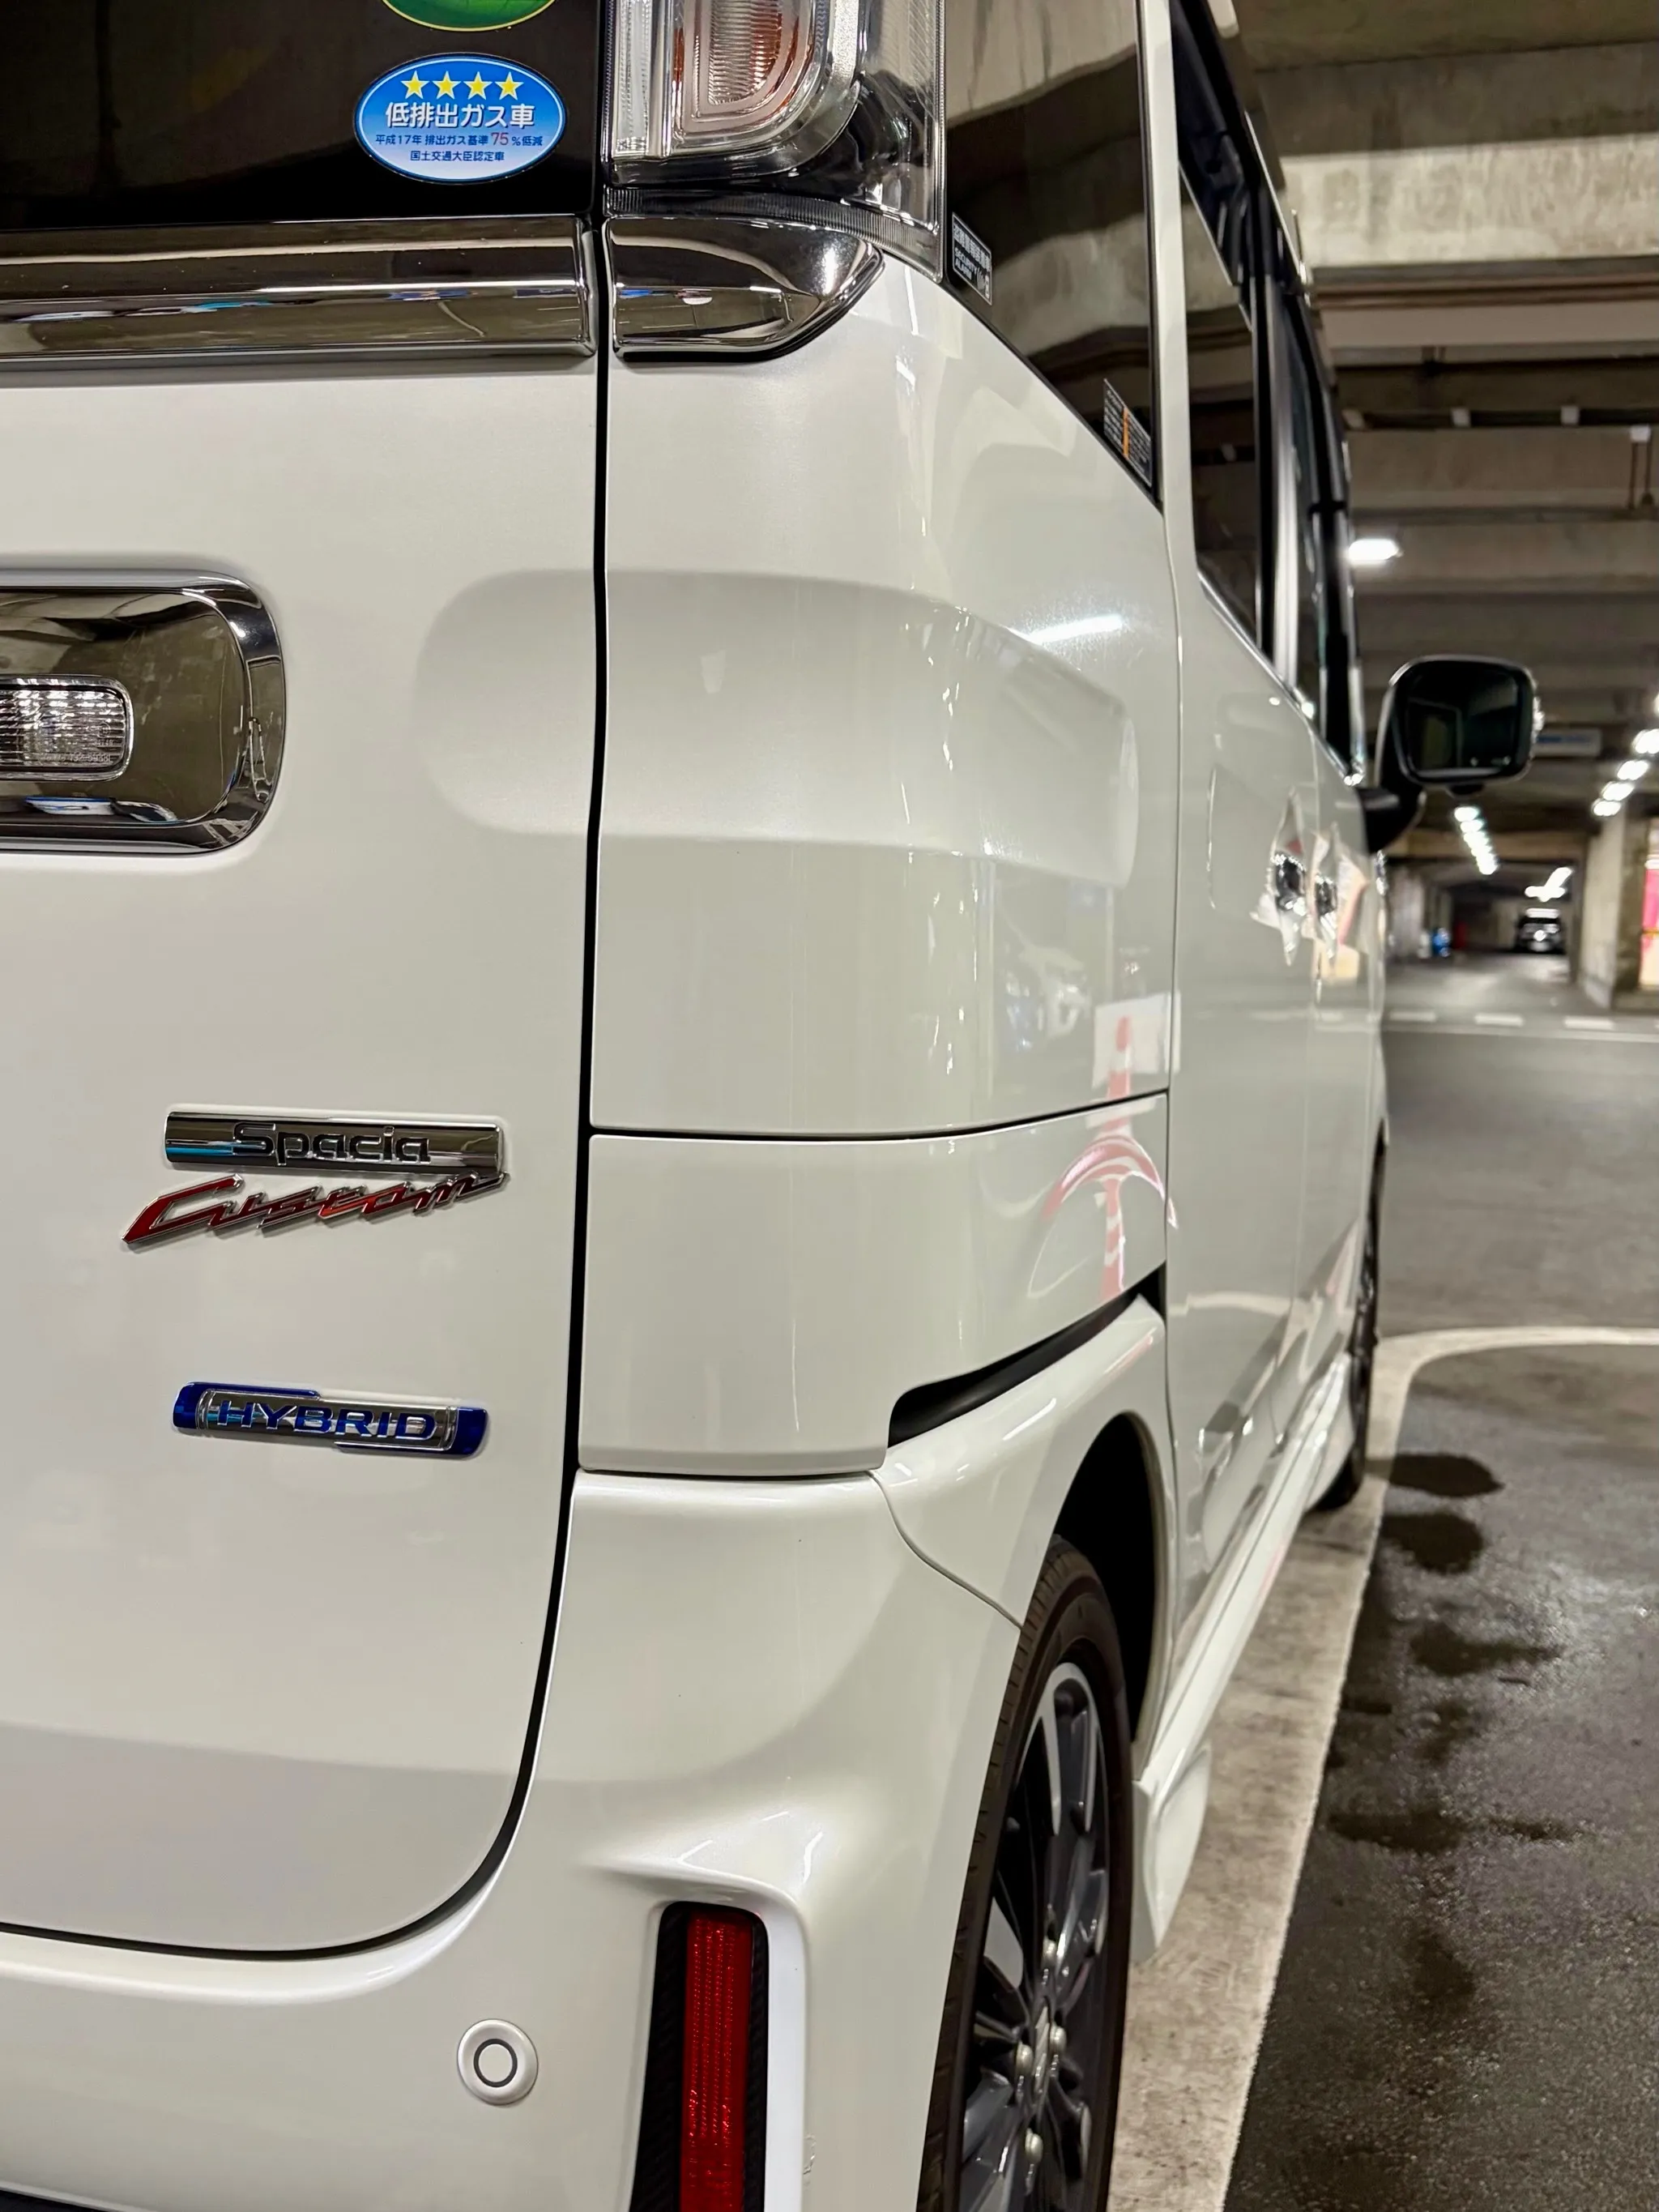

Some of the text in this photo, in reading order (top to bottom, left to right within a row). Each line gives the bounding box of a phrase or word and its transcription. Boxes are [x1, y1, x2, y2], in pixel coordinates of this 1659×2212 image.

[386, 102, 535, 128] 低排出ガス車
[410, 150, 505, 161] 国土交通大臣認定車
[233, 1121, 431, 1165] Spacia
[122, 1172, 508, 1244] Custom
[217, 1399, 437, 1441] HYBRID
